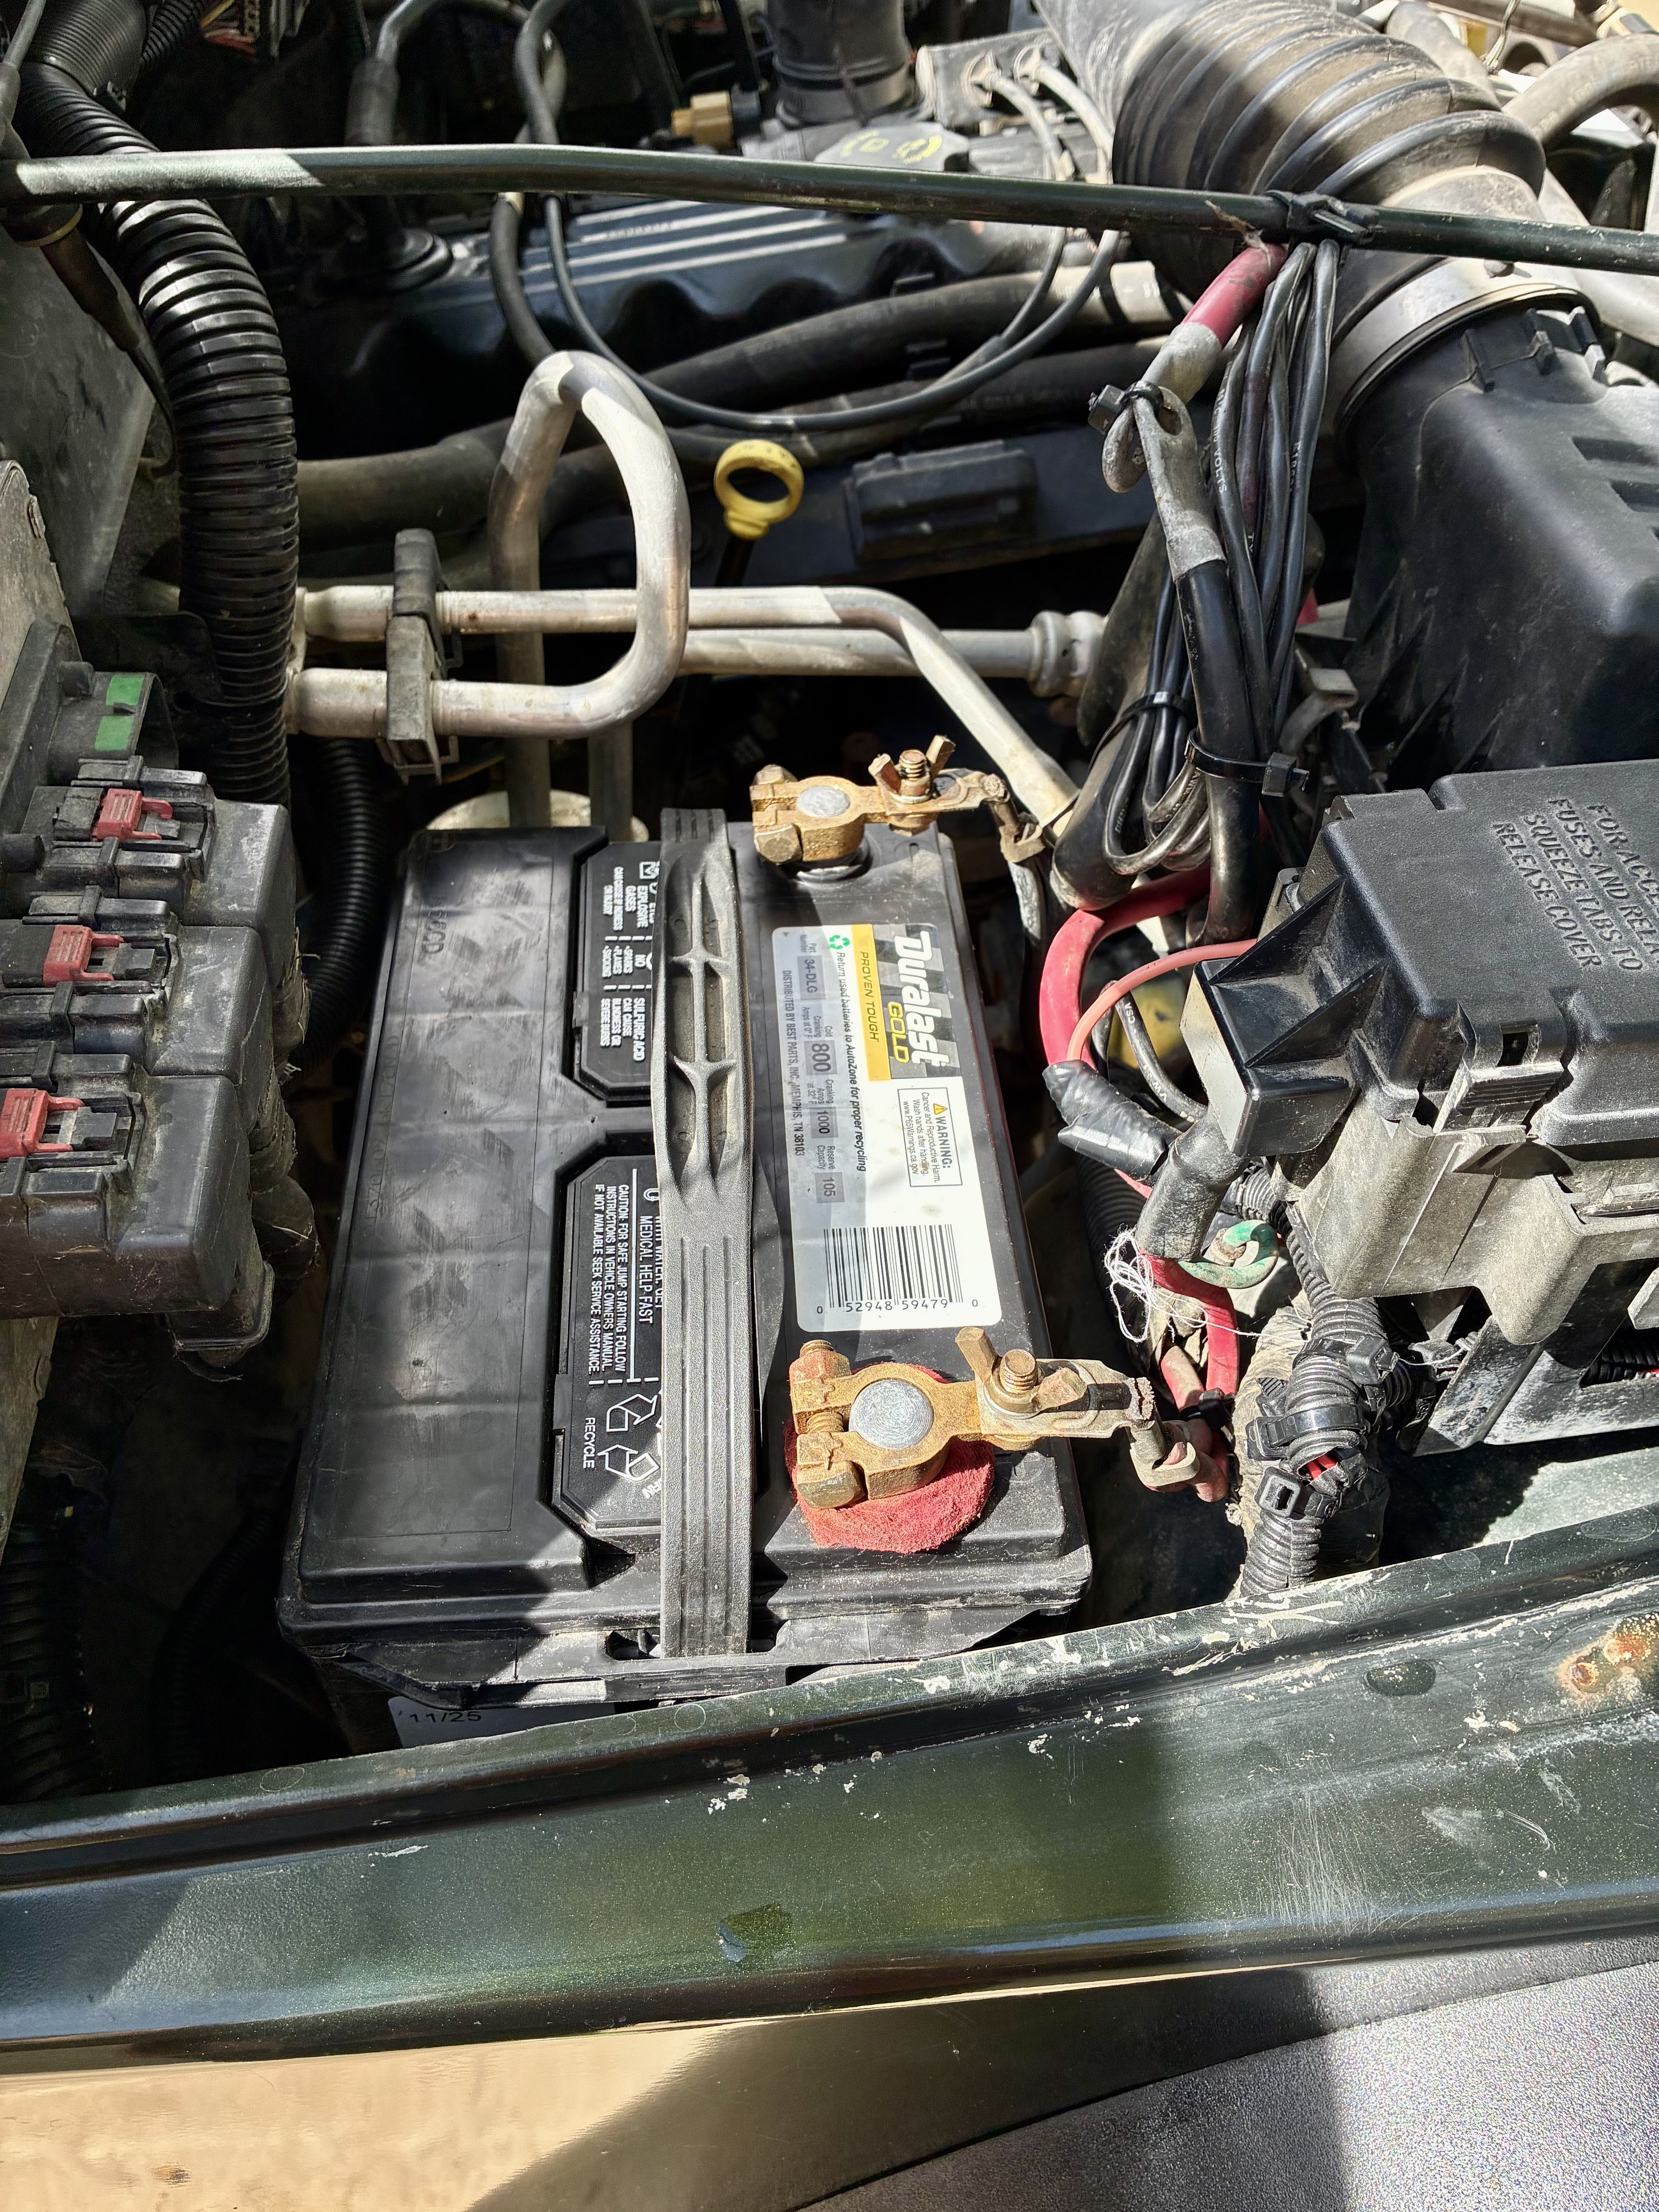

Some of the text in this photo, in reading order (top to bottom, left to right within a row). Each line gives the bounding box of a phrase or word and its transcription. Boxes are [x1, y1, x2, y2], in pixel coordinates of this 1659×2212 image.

[1214, 448, 1227, 493] VOLTS
[1587, 804, 1628, 844] FOR
[1548, 799, 1602, 857] FUSES
[1589, 864, 1630, 900] AND
[625, 885, 636, 912] GASES
[637, 885, 648, 928] EXPLOSIVE
[1492, 823, 1602, 967] RELEASE COVER
[1523, 814, 1643, 970] SQUEEZE TABS TO
[635, 954, 646, 967] NO
[800, 934, 808, 953] Number
[783, 970, 794, 1012] DISTRIBUTED
[805, 959, 818, 993] 34-DLG
[860, 951, 879, 1041] PROVEN TOUGH
[894, 931, 949, 1066] Duralast
[1124, 1002, 1135, 1024] CSA
[623, 998, 632, 1037] CAN CAUSE
[633, 998, 645, 1061] SULFURIC ACID
[785, 1013, 795, 1022] BY
[803, 1007, 811, 1020] Amps
[813, 1015, 822, 1037] Cranking
[611, 1035, 621, 1046] OR
[787, 1023, 796, 1040] BEST
[825, 1025, 833, 1037] Cold
[888, 1001, 909, 1063] GOLD
[788, 1041, 799, 1068] PARTS,
[811, 1043, 831, 1072] 800
[837, 952, 868, 1172] Return used batteries to AutoZone for proper recycling
[791, 1085, 802, 1120] MEMPHIS,
[816, 1088, 824, 1104] Amps
[826, 1079, 834, 1103] Cranking
[793, 1122, 804, 1132] TN
[817, 1110, 830, 1134] 1000
[903, 1101, 919, 1175] www.P65Warnings.ca.gov
[913, 1099, 922, 1115] Wash
[920, 1149, 929, 1176] handling.
[922, 1092, 941, 1183] Cancer and Reproductive Harm.
[794, 1133, 805, 1156] 38103
[817, 1145, 826, 1170] Capacity
[827, 1146, 835, 1170] Reserve
[935, 1116, 953, 1169] WARNING:
[823, 1177, 836, 1197] 105
[588, 1184, 605, 1375] IF NOT AVAILABLE SEEK SERVICE ASSISTANCE.
[601, 1186, 617, 1372] INSTRUCTIONS IN VEHICLE OWNERS MANUAL.
[615, 1184, 629, 1372] CAUTION: FOR SAFE JUMP STARTING FOLLOW
[639, 1215, 653, 1324] MEDICAL HELP FAST
[817, 1306, 823, 1314] 0
[846, 1301, 893, 1312] 52948
[902, 1299, 948, 1310] 59479
[583, 1417, 596, 1468] RECYCLE
[409, 1711, 482, 1723] 11/25
